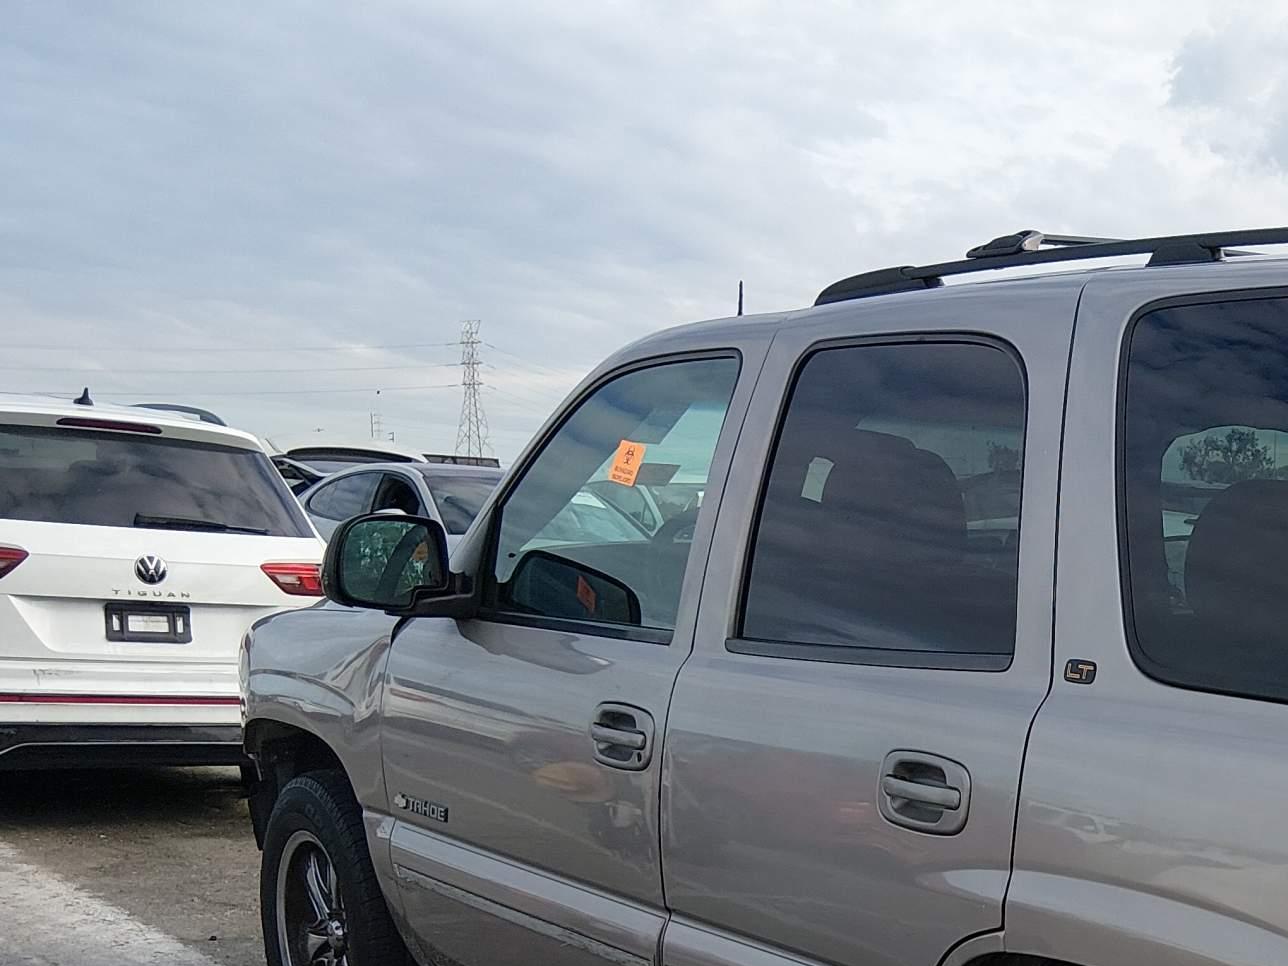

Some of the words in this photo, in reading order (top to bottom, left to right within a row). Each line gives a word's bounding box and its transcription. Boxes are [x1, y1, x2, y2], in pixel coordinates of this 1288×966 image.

[112, 588, 190, 598] TIGUAN
[1066, 662, 1094, 680] LT
[408, 797, 448, 822] TAHOE
